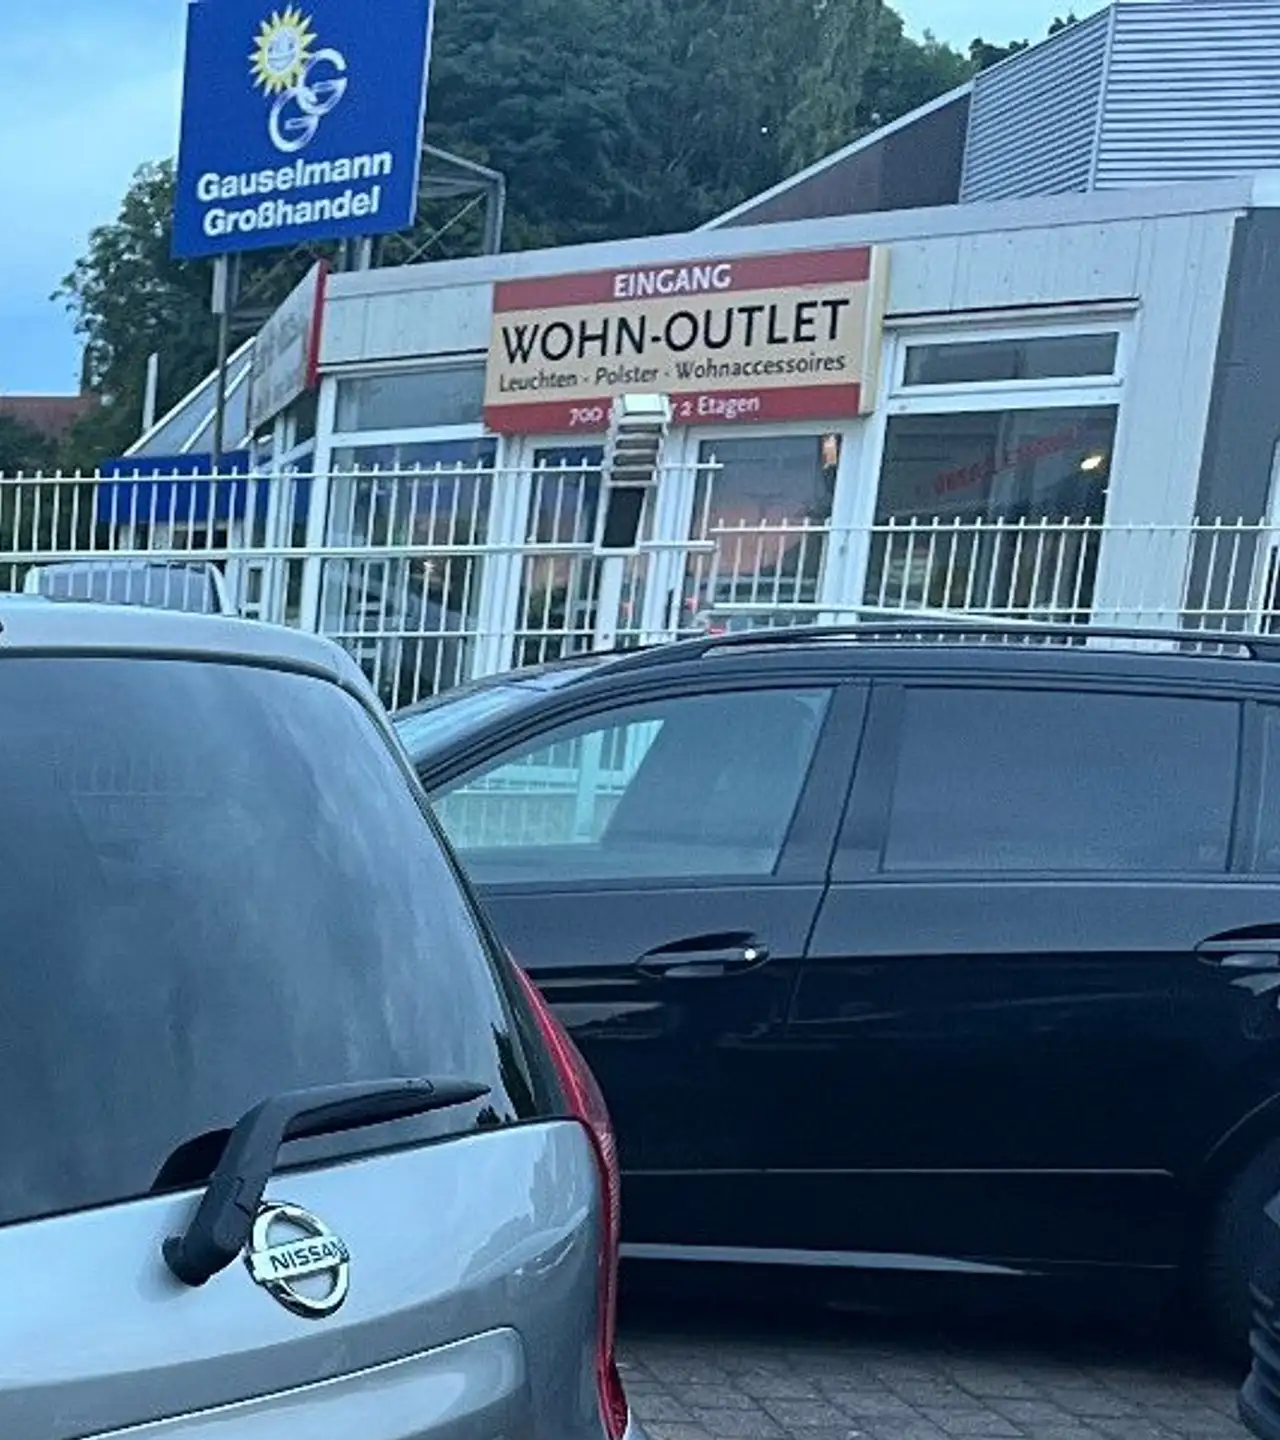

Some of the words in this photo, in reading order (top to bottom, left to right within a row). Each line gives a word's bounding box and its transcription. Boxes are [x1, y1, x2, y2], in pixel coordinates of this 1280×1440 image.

[197, 151, 393, 201] Gauselmann
[203, 185, 381, 236] Großhandel
[614, 264, 732, 297] EINGANG
[501, 299, 850, 364] WOHN-OUTLET
[499, 368, 578, 392] Leuchten
[595, 364, 659, 386] Polster
[675, 352, 846, 380] Wohnaccessoires
[568, 406, 604, 427] 700
[679, 401, 693, 417] 2
[696, 395, 760, 420] Etagen
[269, 1240, 349, 1273] NISSAN
